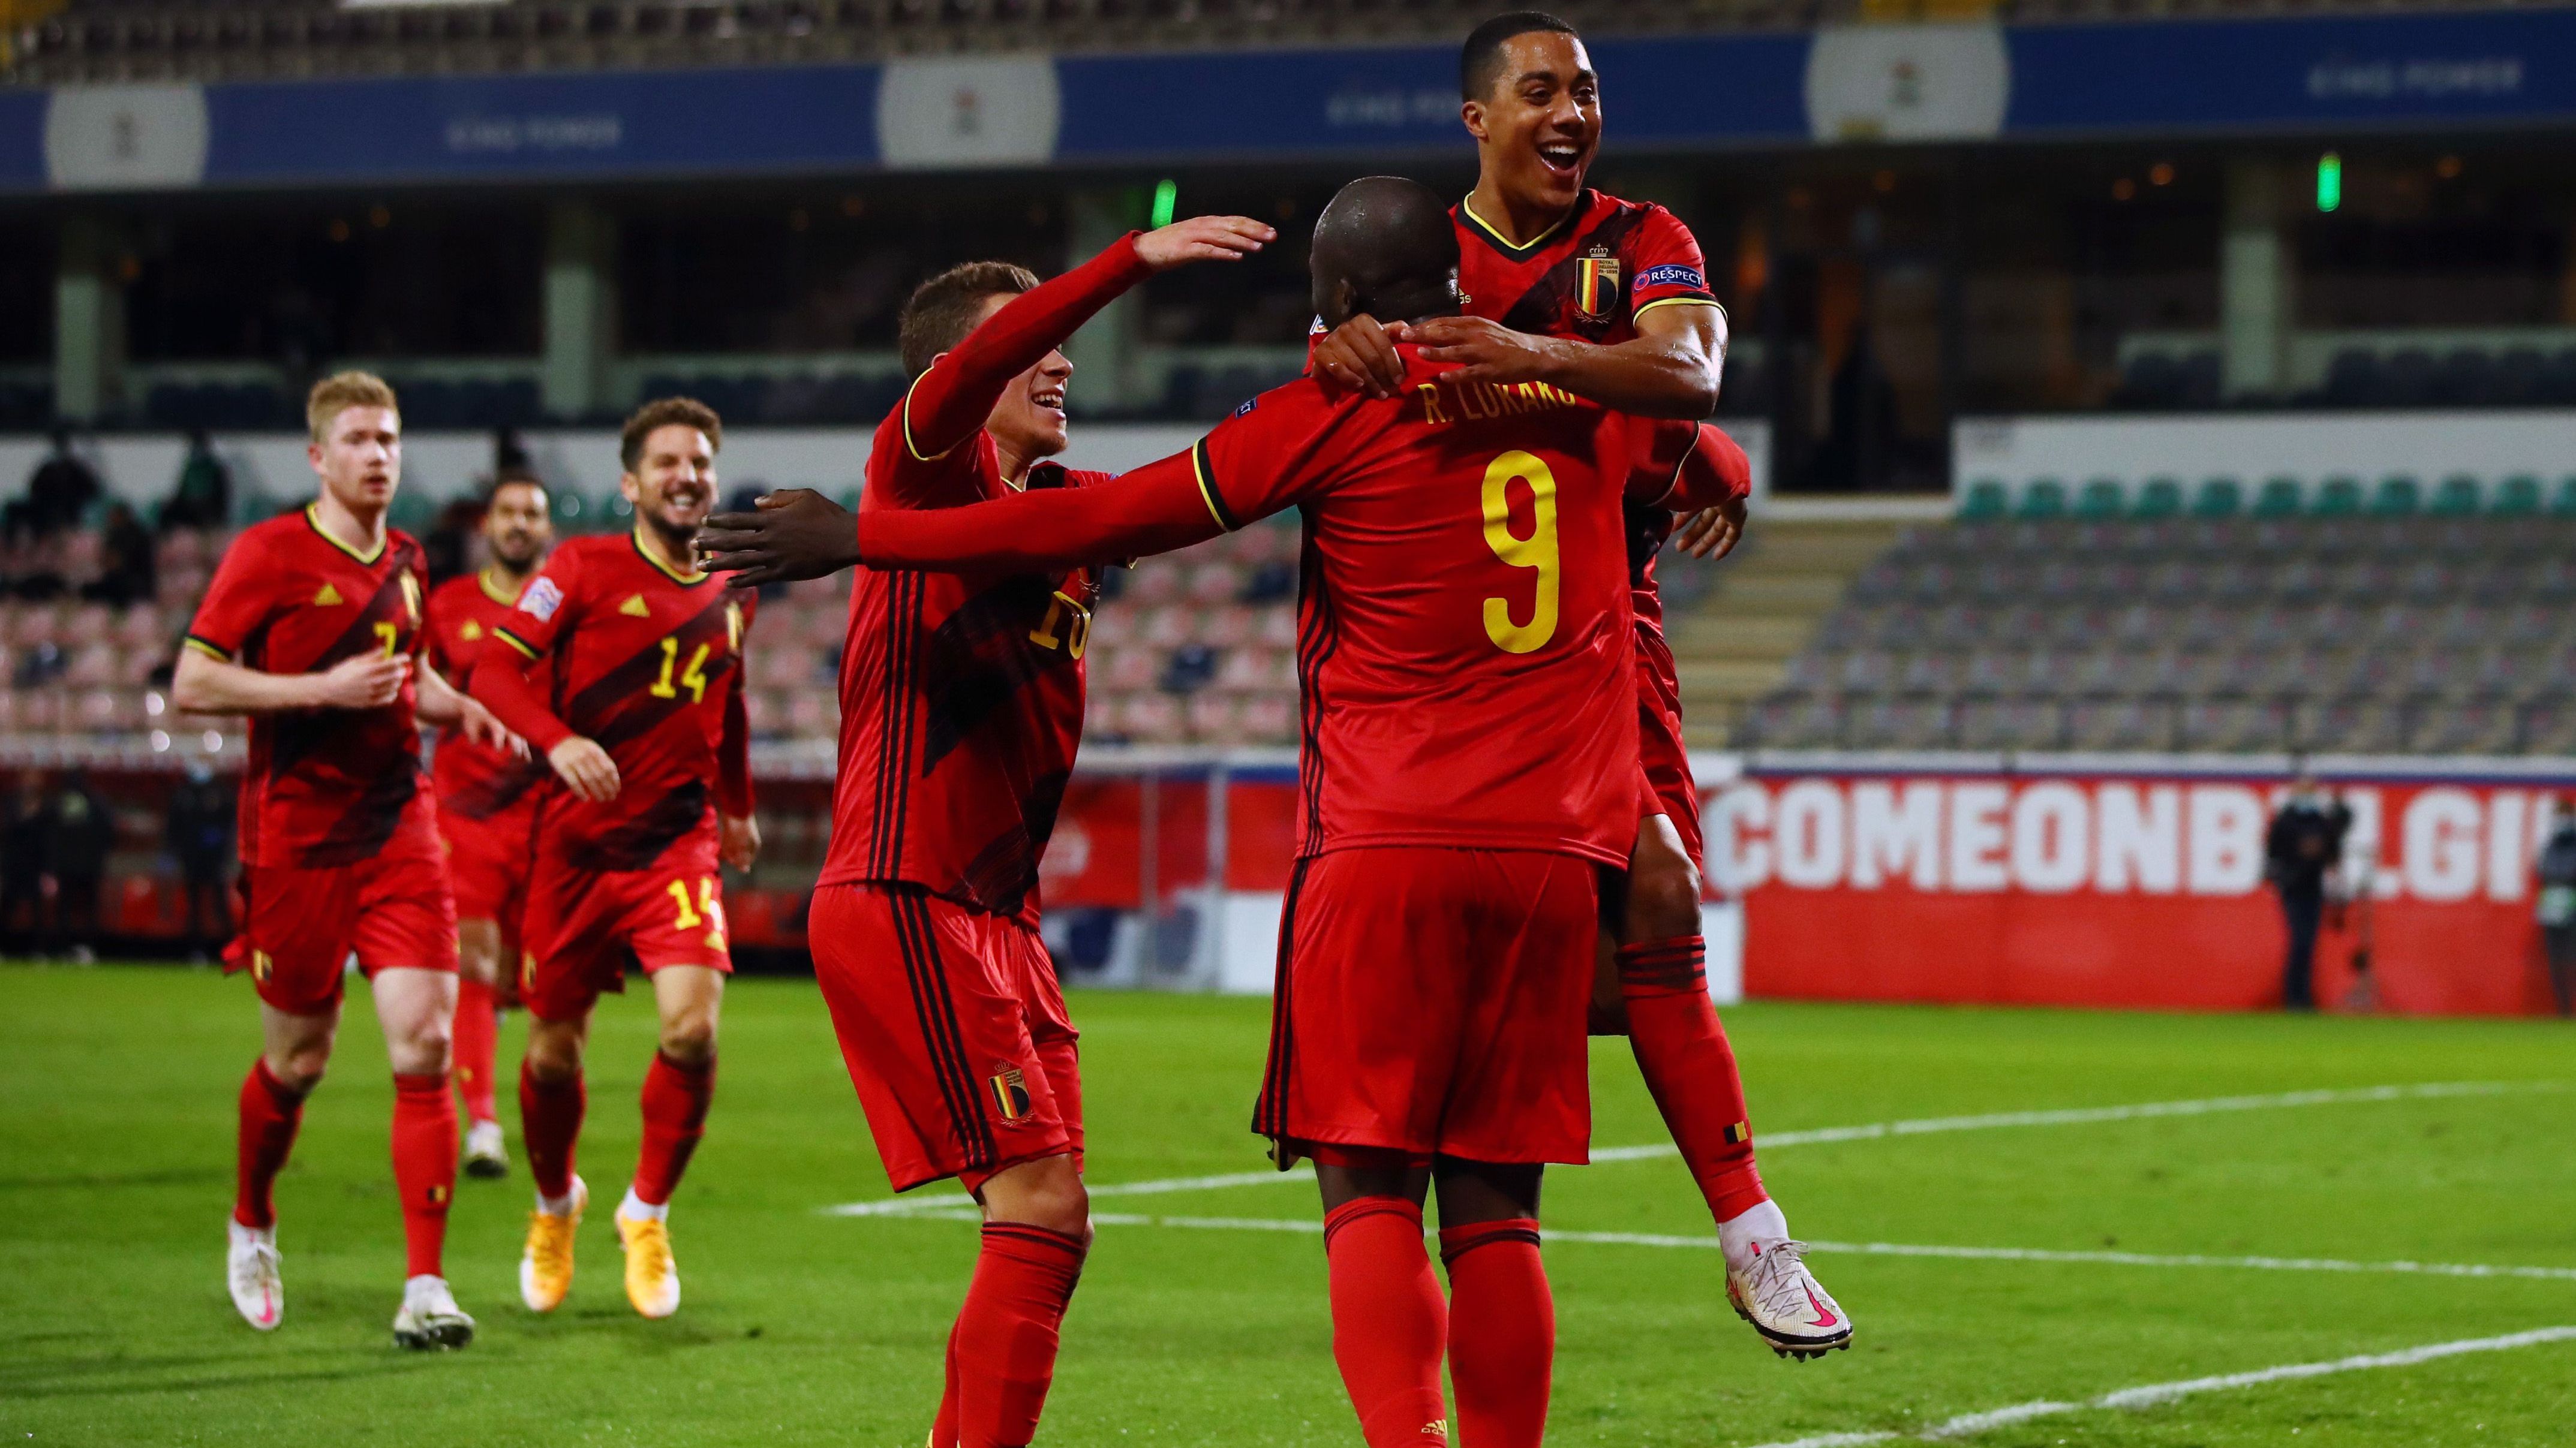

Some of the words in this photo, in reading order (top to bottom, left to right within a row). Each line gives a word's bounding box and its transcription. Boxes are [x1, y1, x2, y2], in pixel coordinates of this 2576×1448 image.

[1651, 270, 1702, 285] RESPECT
[1418, 383, 1454, 424] R.
[1481, 450, 1559, 654] 9
[374, 621, 397, 659] 7
[1029, 591, 1091, 660] 10
[650, 636, 710, 705] 14
[666, 876, 723, 931] 14
